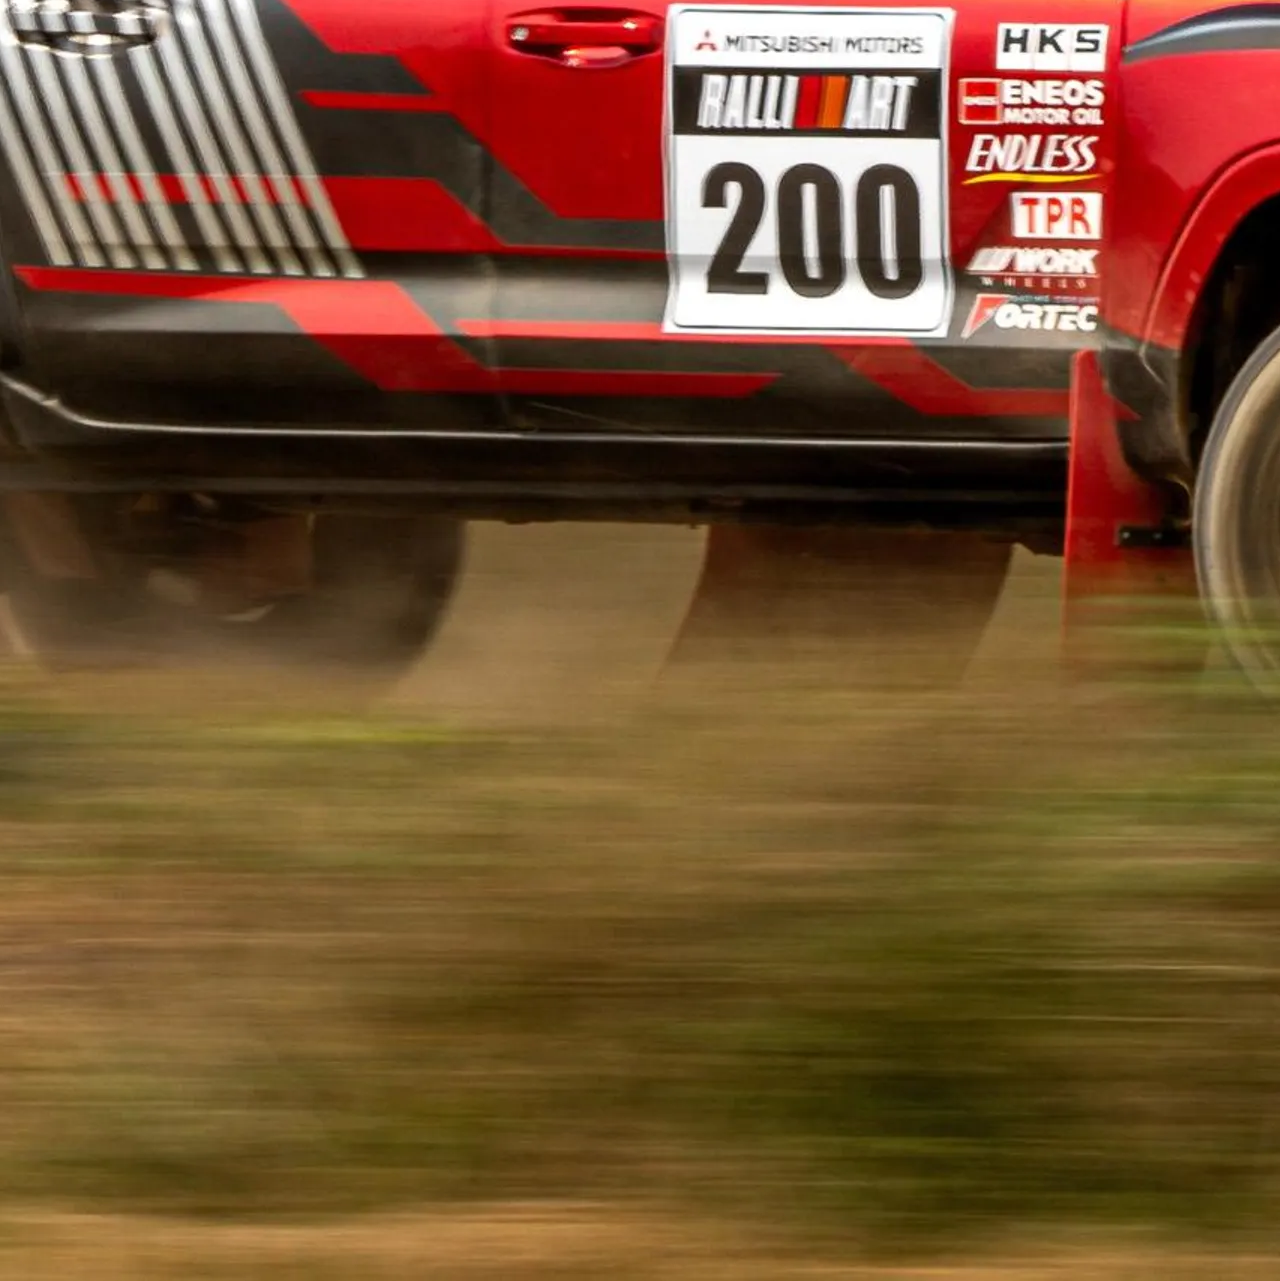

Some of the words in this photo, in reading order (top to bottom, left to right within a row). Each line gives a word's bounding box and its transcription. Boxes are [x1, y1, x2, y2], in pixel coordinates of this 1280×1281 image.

[723, 35, 835, 53] MITSUBISHI
[846, 36, 924, 54] MOTORS
[1002, 28, 1101, 54] HKS
[1002, 79, 1106, 106] ENEOS
[1004, 107, 1070, 125] MOTOR
[1072, 108, 1105, 125] OIL
[965, 133, 1100, 172] ENDLESS
[1020, 198, 1090, 234] TPR
[700, 161, 924, 300] 200
[1014, 247, 1100, 274] WORK
